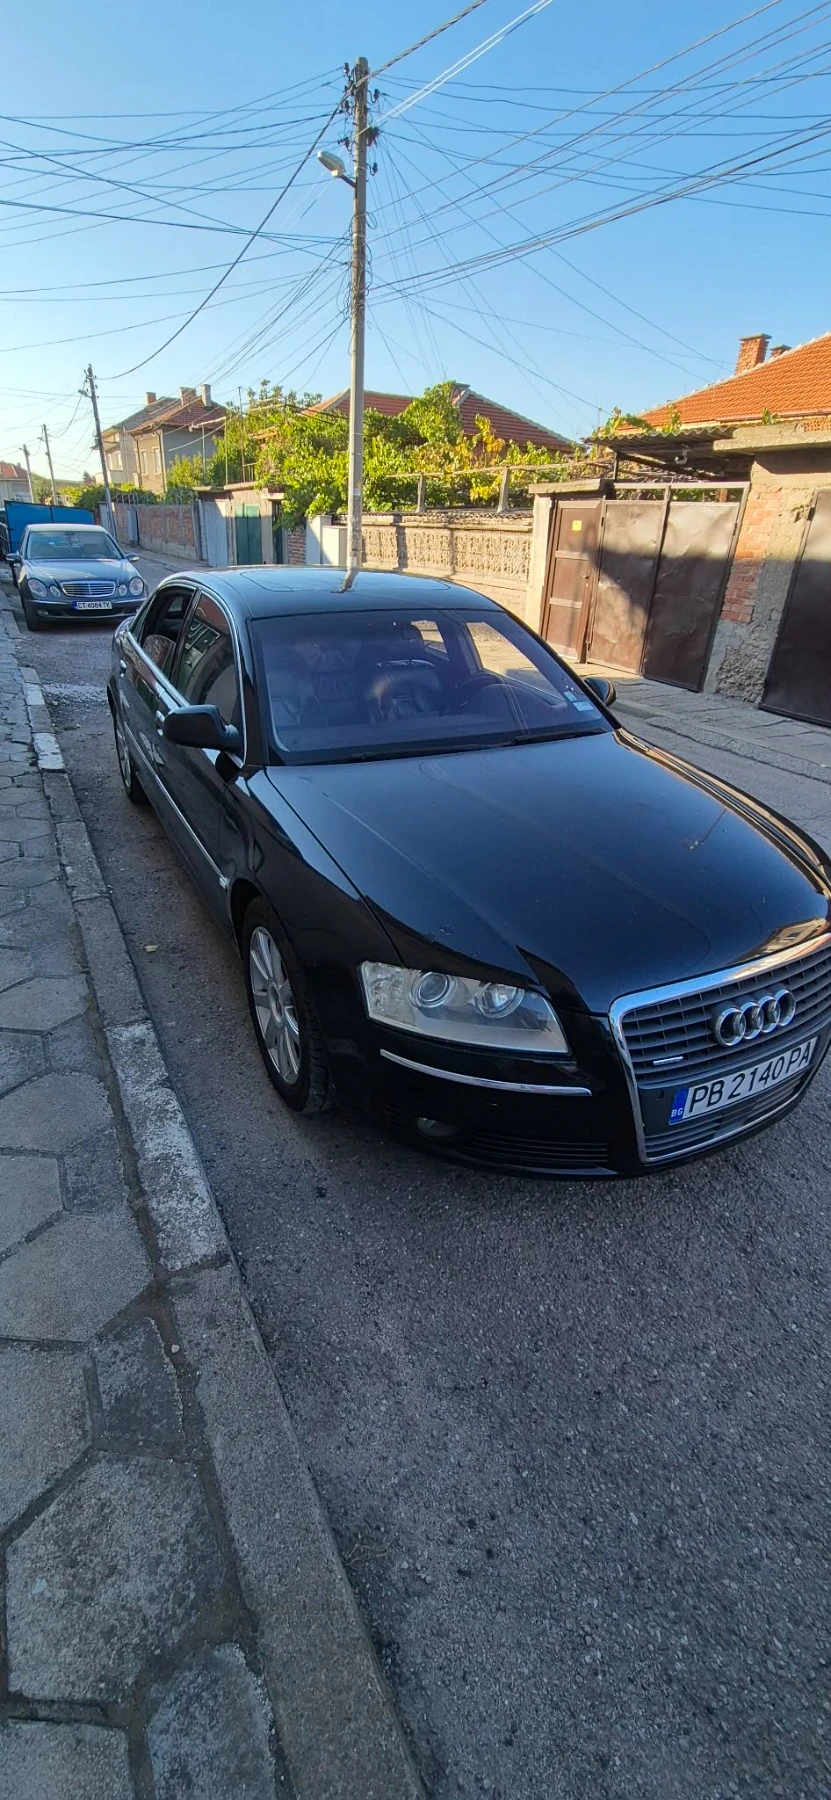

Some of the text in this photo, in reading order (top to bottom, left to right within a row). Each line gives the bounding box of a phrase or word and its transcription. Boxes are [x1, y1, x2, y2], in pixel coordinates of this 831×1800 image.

[689, 1041, 812, 1113] PB 2140 PA
[671, 1108, 684, 1117] BG
